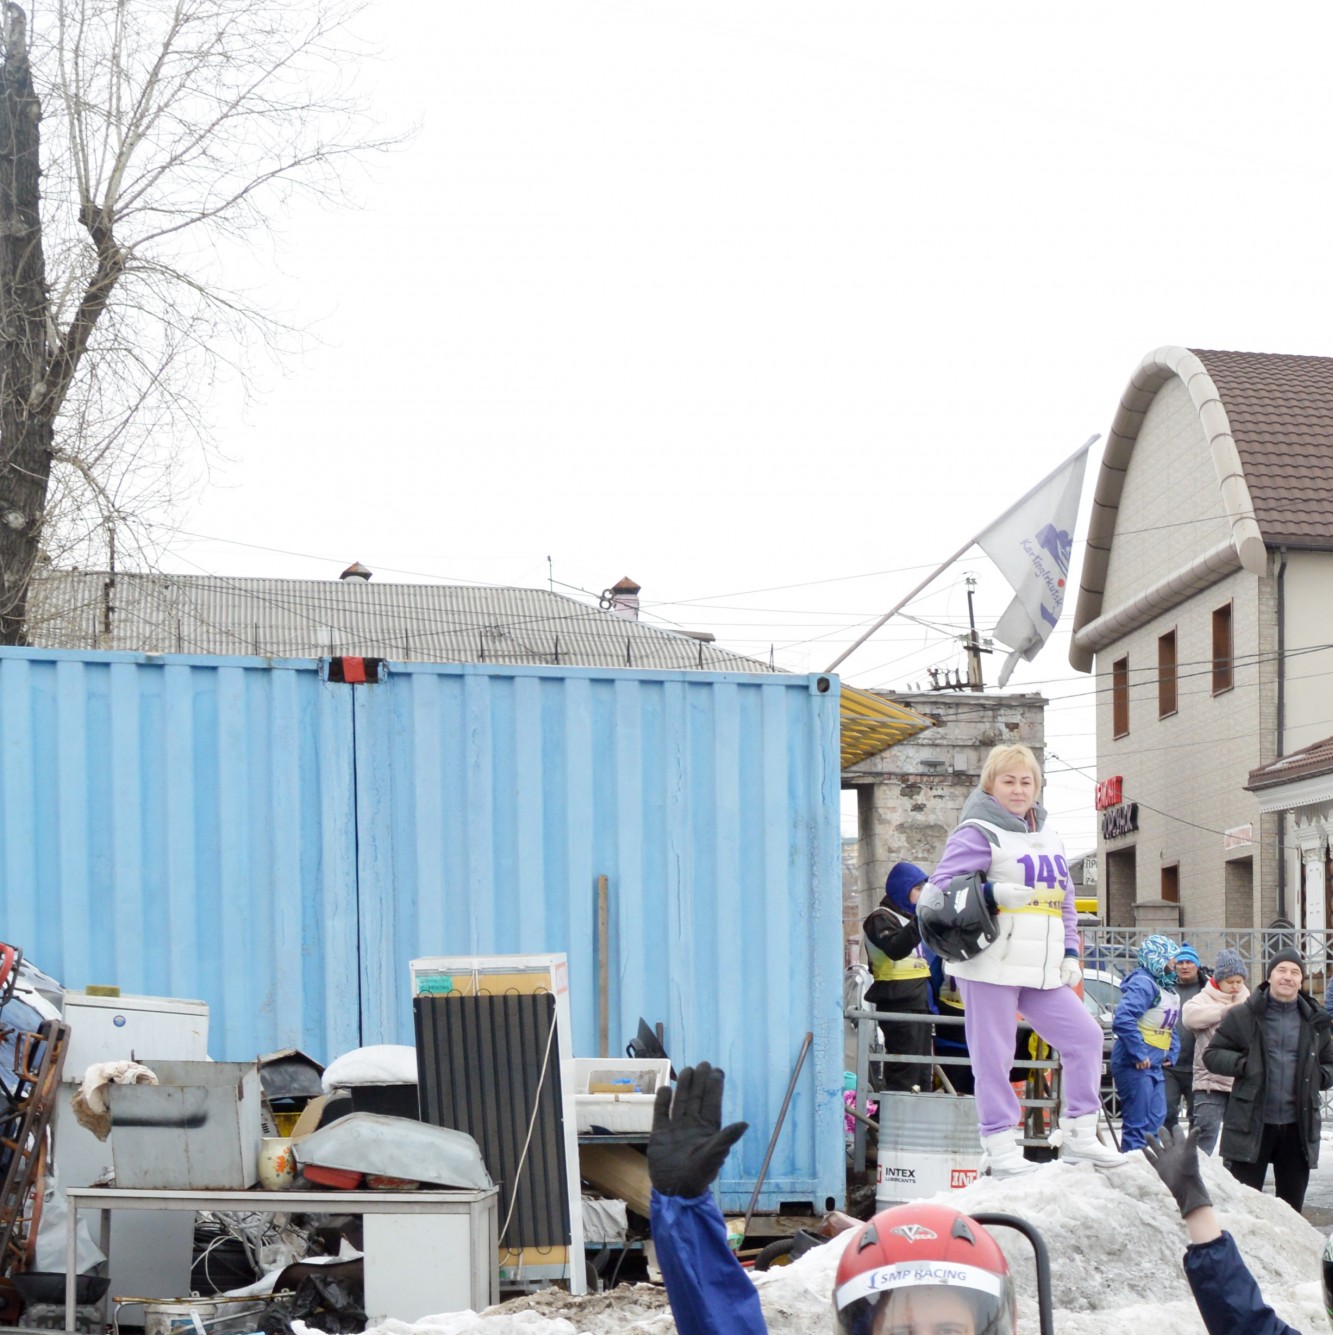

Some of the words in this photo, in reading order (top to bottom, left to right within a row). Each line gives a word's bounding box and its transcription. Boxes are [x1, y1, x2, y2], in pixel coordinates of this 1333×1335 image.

[1017, 855, 1068, 891] 149
[885, 1167, 916, 1178] INTEX
[881, 1270, 911, 1285] SMP
[914, 1269, 967, 1281] RACING
